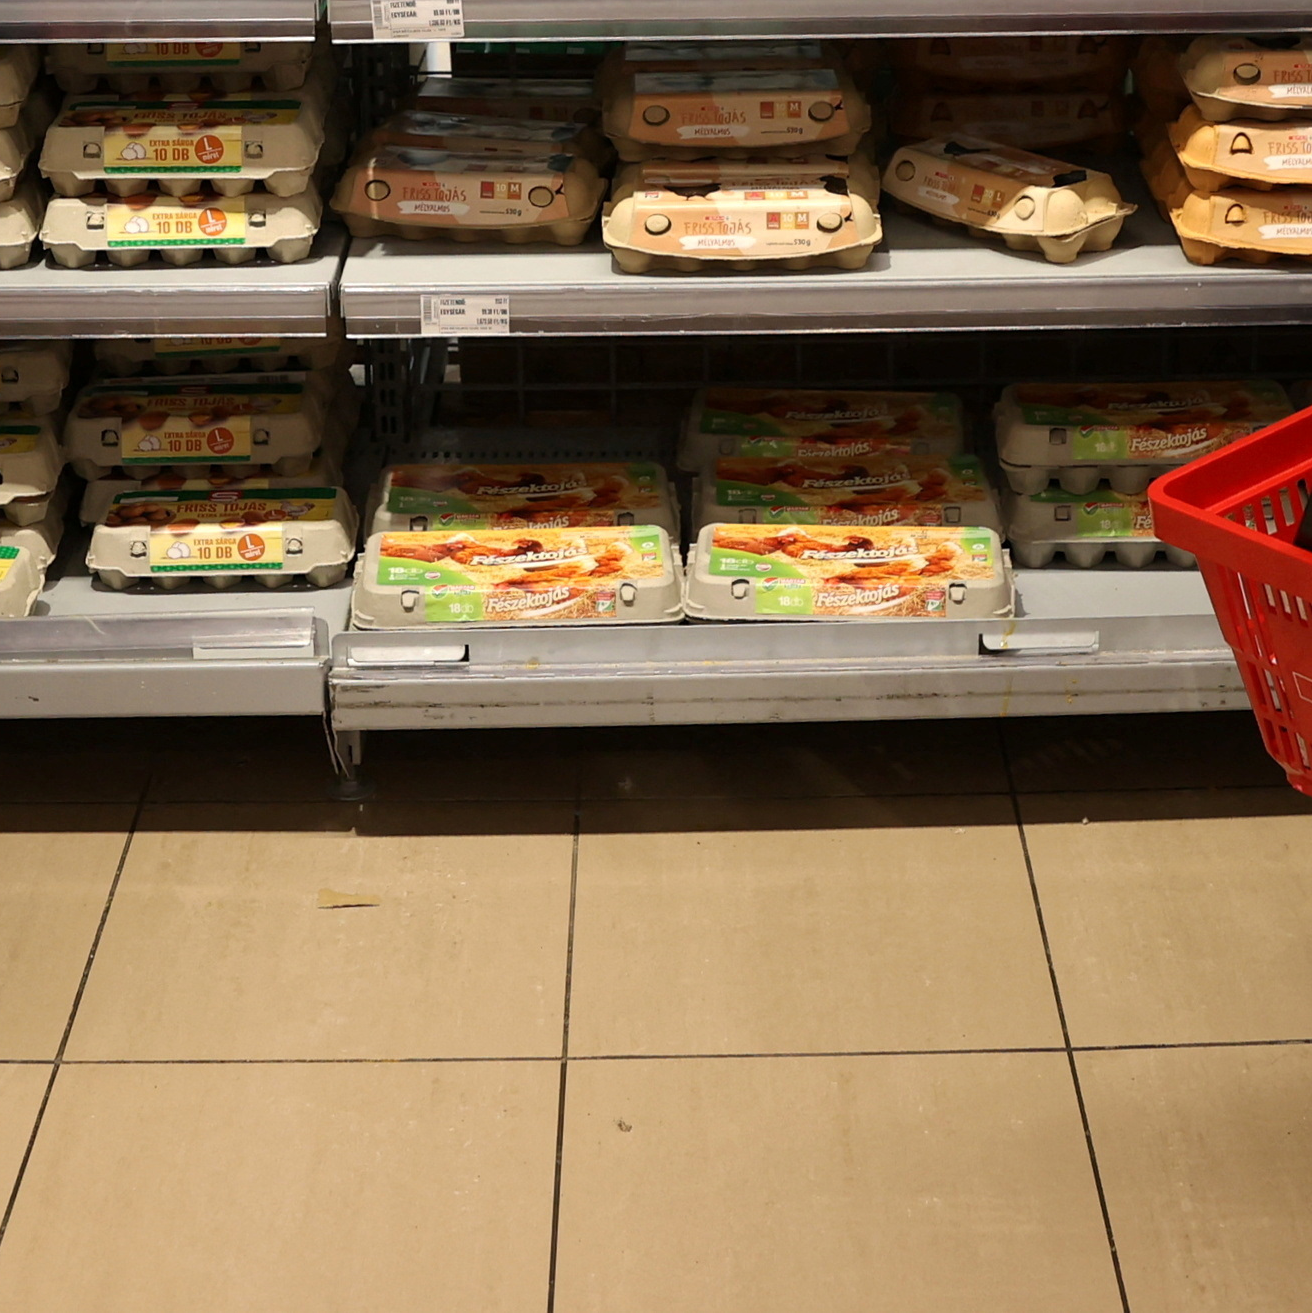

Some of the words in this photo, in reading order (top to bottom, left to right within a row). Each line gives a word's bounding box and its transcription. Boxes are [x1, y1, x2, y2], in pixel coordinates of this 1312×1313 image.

[1274, 70, 1303, 83] FRISS
[203, 137, 213, 151] L
[153, 149, 167, 161] 10
[173, 149, 190, 161] DB
[403, 187, 431, 200] FRISS
[435, 187, 466, 202] TOJÁS
[510, 184, 519, 192] M
[157, 222, 170, 234] 10
[176, 221, 193, 234] DB
[684, 222, 714, 235] FRISS
[718, 220, 752, 235] TOJÁS
[1131, 427, 1207, 452] Fészektojás
[177, 504, 217, 513] FRISS
[216, 537, 237, 545] SÁRGA
[246, 535, 254, 549] L
[198, 547, 211, 560] 10
[217, 547, 233, 559] DB
[470, 547, 589, 566] Fészektojás
[800, 545, 919, 560] Fészektojás
[486, 586, 570, 613] Fészektojás
[816, 584, 900, 607] Fészektojás
